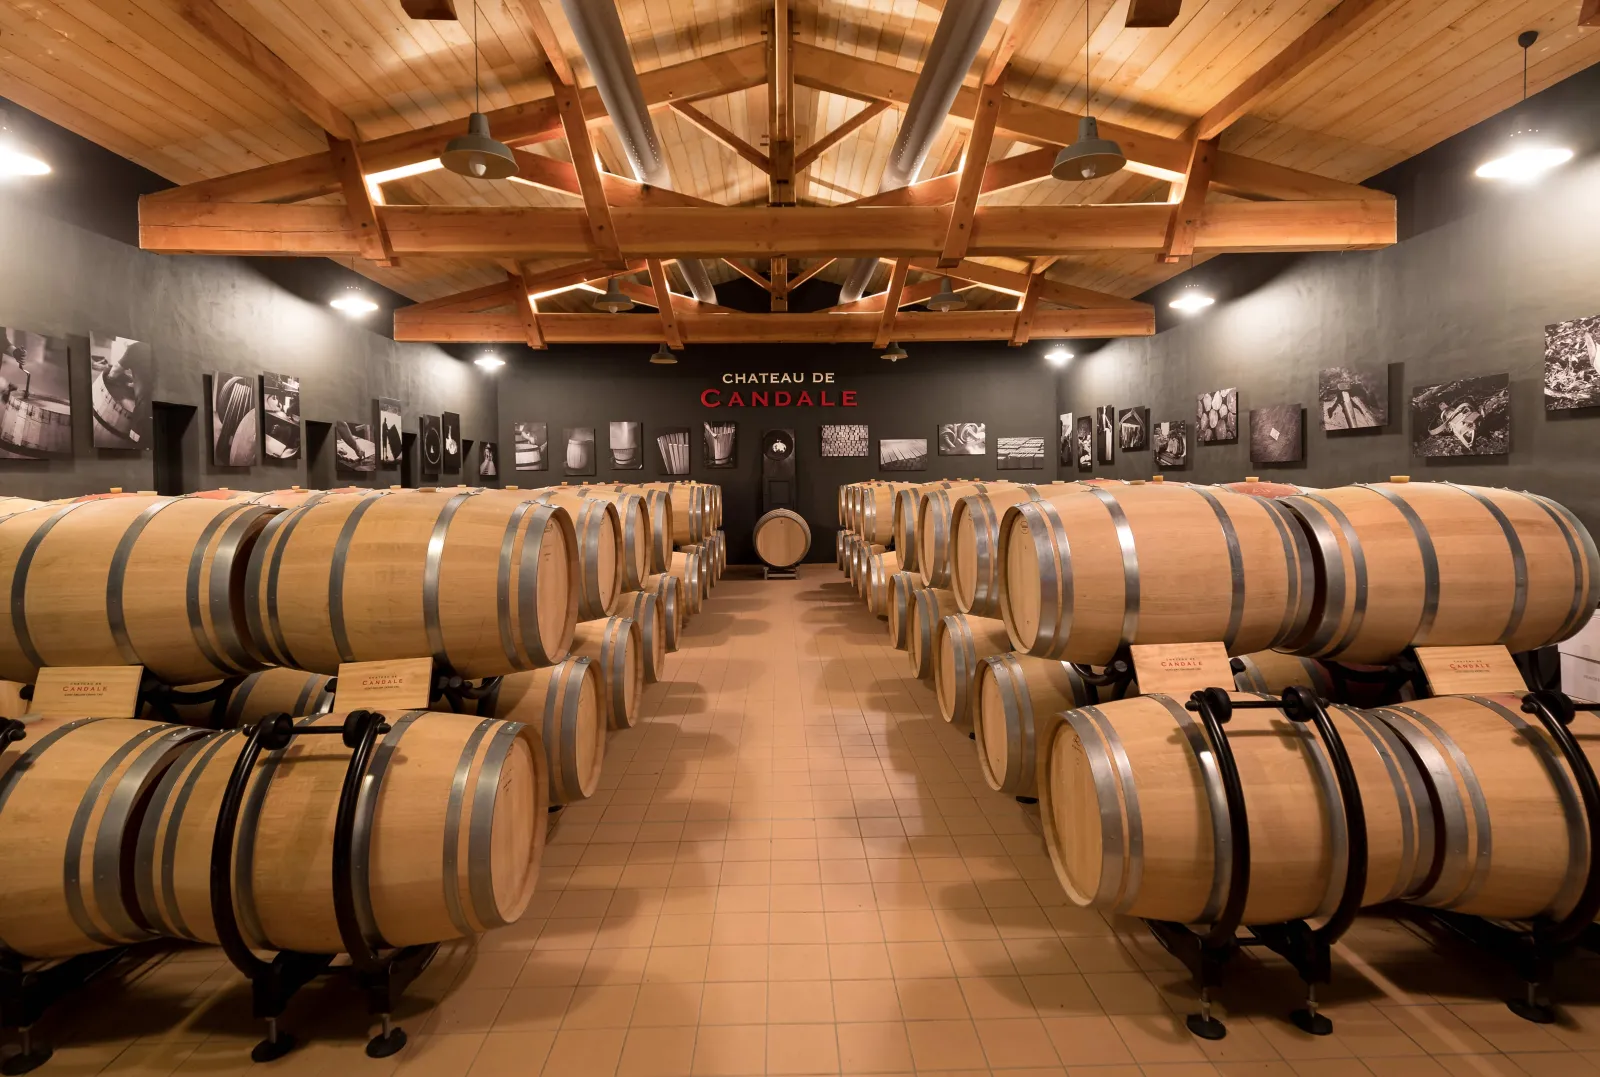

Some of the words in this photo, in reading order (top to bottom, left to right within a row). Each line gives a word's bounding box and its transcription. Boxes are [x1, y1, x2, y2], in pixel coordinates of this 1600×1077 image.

[722, 372, 804, 384] CHATEAU
[812, 372, 835, 384] DE
[700, 388, 858, 408] CANDALE
